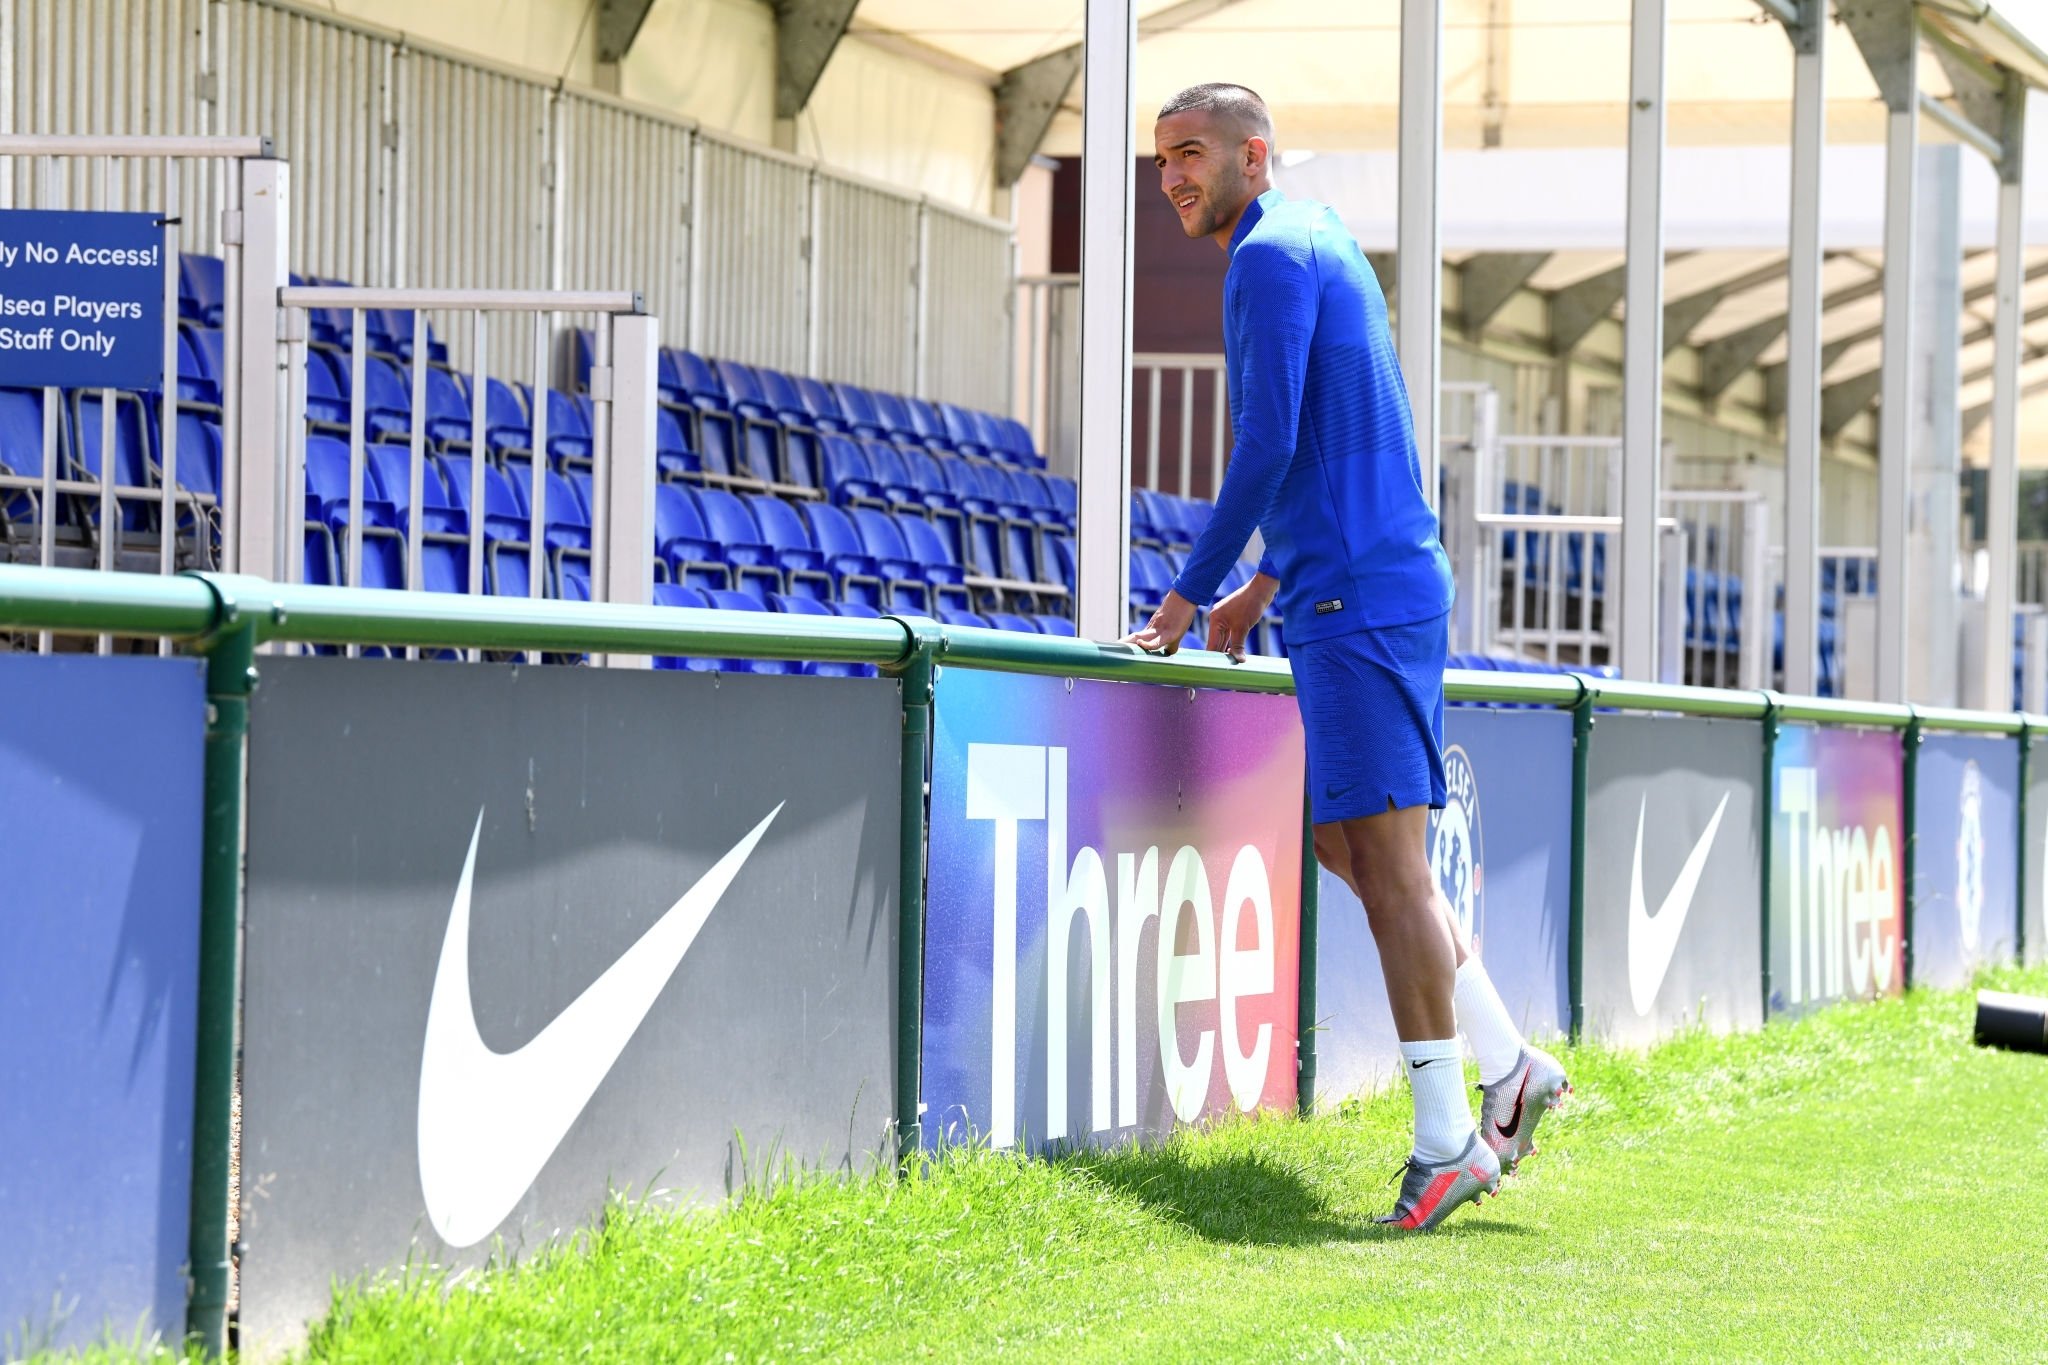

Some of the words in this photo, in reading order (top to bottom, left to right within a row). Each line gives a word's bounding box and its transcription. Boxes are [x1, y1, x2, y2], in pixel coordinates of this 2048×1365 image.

[25, 242, 59, 264] No
[65, 243, 158, 266] Access!
[54, 295, 142, 322] Players
[0, 327, 54, 350] Staff
[60, 329, 116, 357] Only
[1780, 767, 1894, 1004] Three
[966, 743, 1274, 1148] Three
